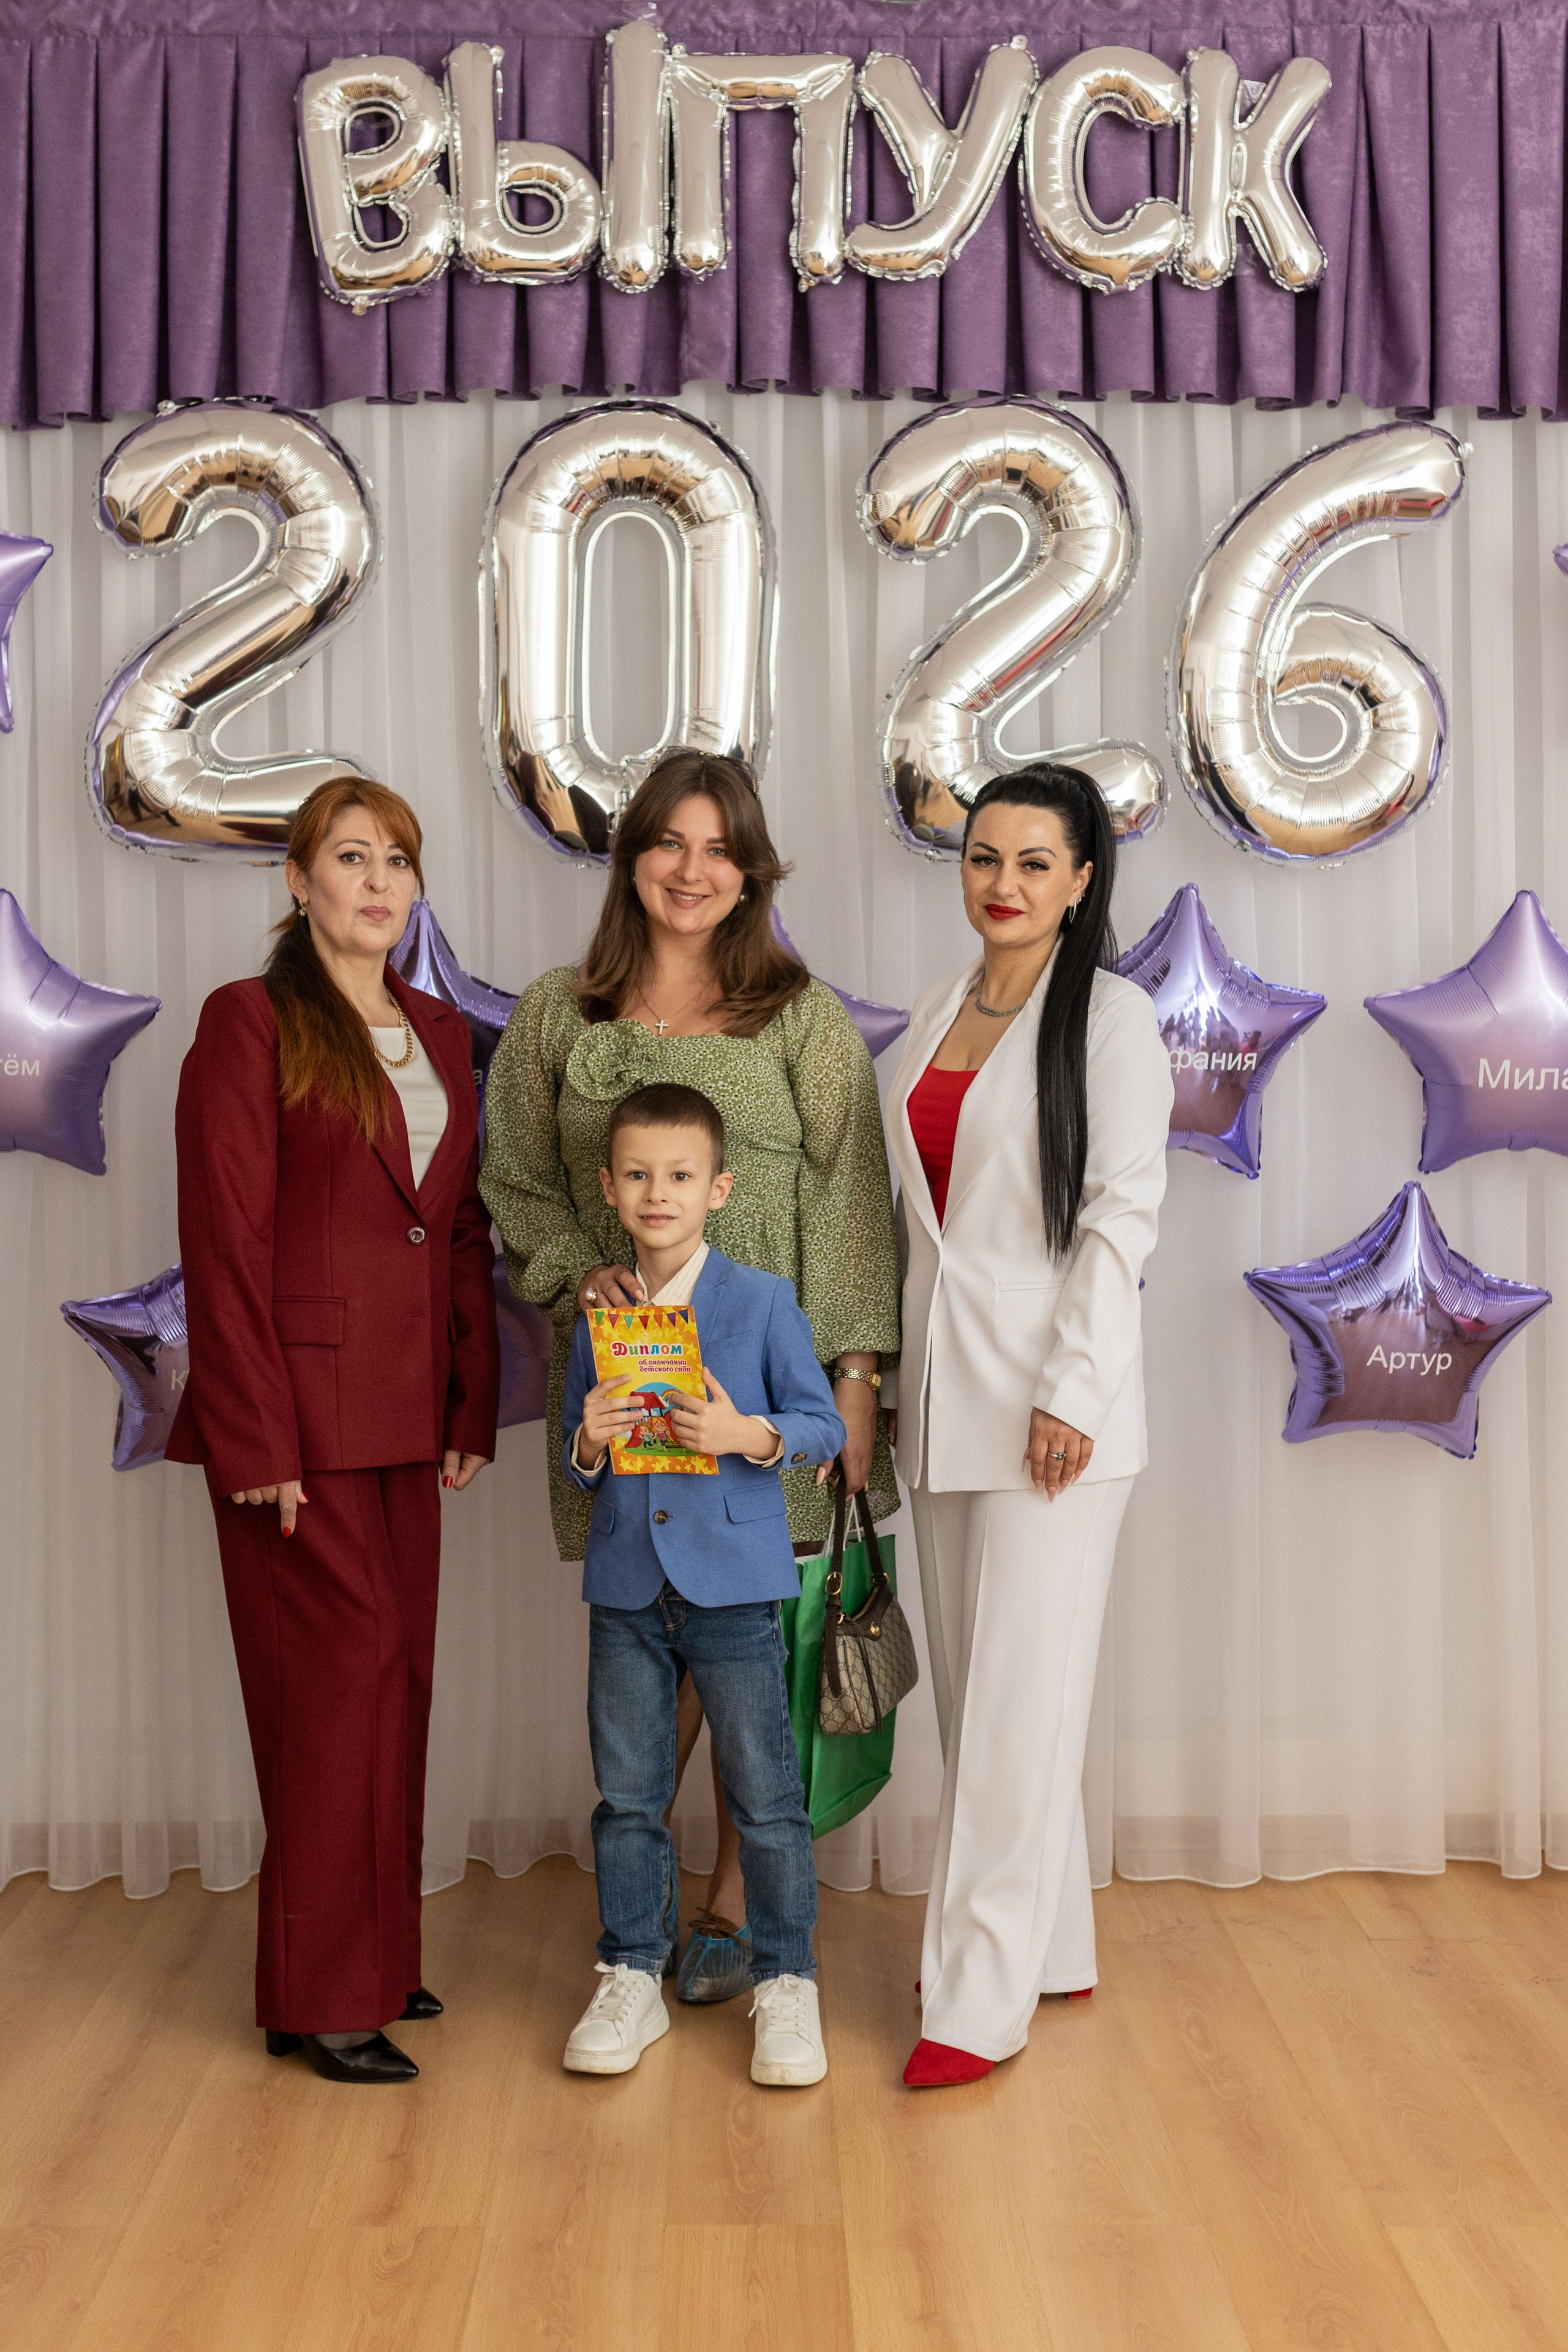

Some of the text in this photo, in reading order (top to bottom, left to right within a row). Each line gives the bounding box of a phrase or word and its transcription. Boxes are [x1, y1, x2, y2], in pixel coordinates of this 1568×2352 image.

[298, 20, 1332, 311] ВЫПУСК
[86, 395, 1475, 867] 2026
[0, 1053, 40, 1076] ём
[611, 1341, 683, 1357] Диплом
[1366, 1344, 1452, 1376] Артур
